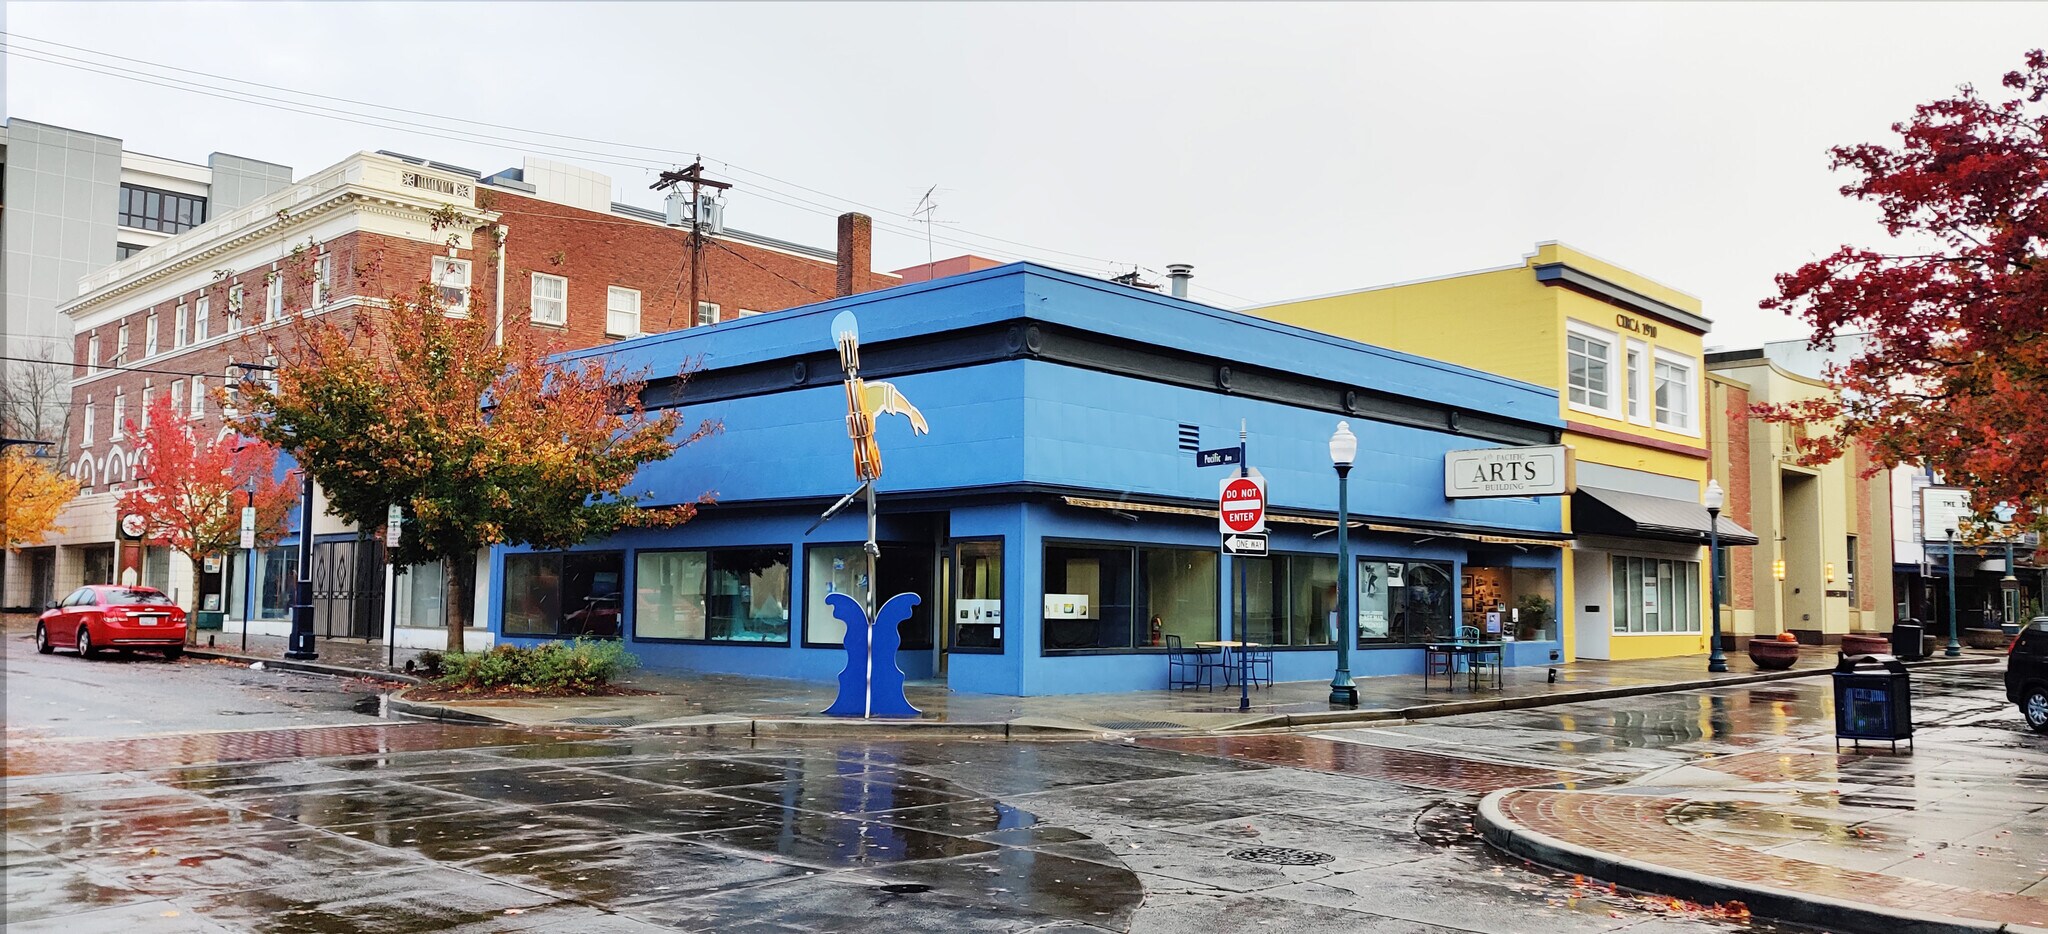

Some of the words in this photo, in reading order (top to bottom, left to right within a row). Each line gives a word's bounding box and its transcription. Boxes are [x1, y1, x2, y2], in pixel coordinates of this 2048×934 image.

[1616, 314, 1640, 333] CIRCA
[1642, 323, 1658, 338] 1910
[1204, 452, 1221, 464] Pacific
[1224, 454, 1232, 462] Ave
[1496, 453, 1525, 461] PACIFIC
[1472, 461, 1537, 482] ARTS
[1485, 483, 1524, 491] BUILDING
[1226, 490, 1237, 498] DO
[1241, 488, 1257, 497] NOT
[1229, 512, 1254, 522] ENTER
[1236, 539, 1248, 548] ONE
[1250, 540, 1263, 548] WAY
